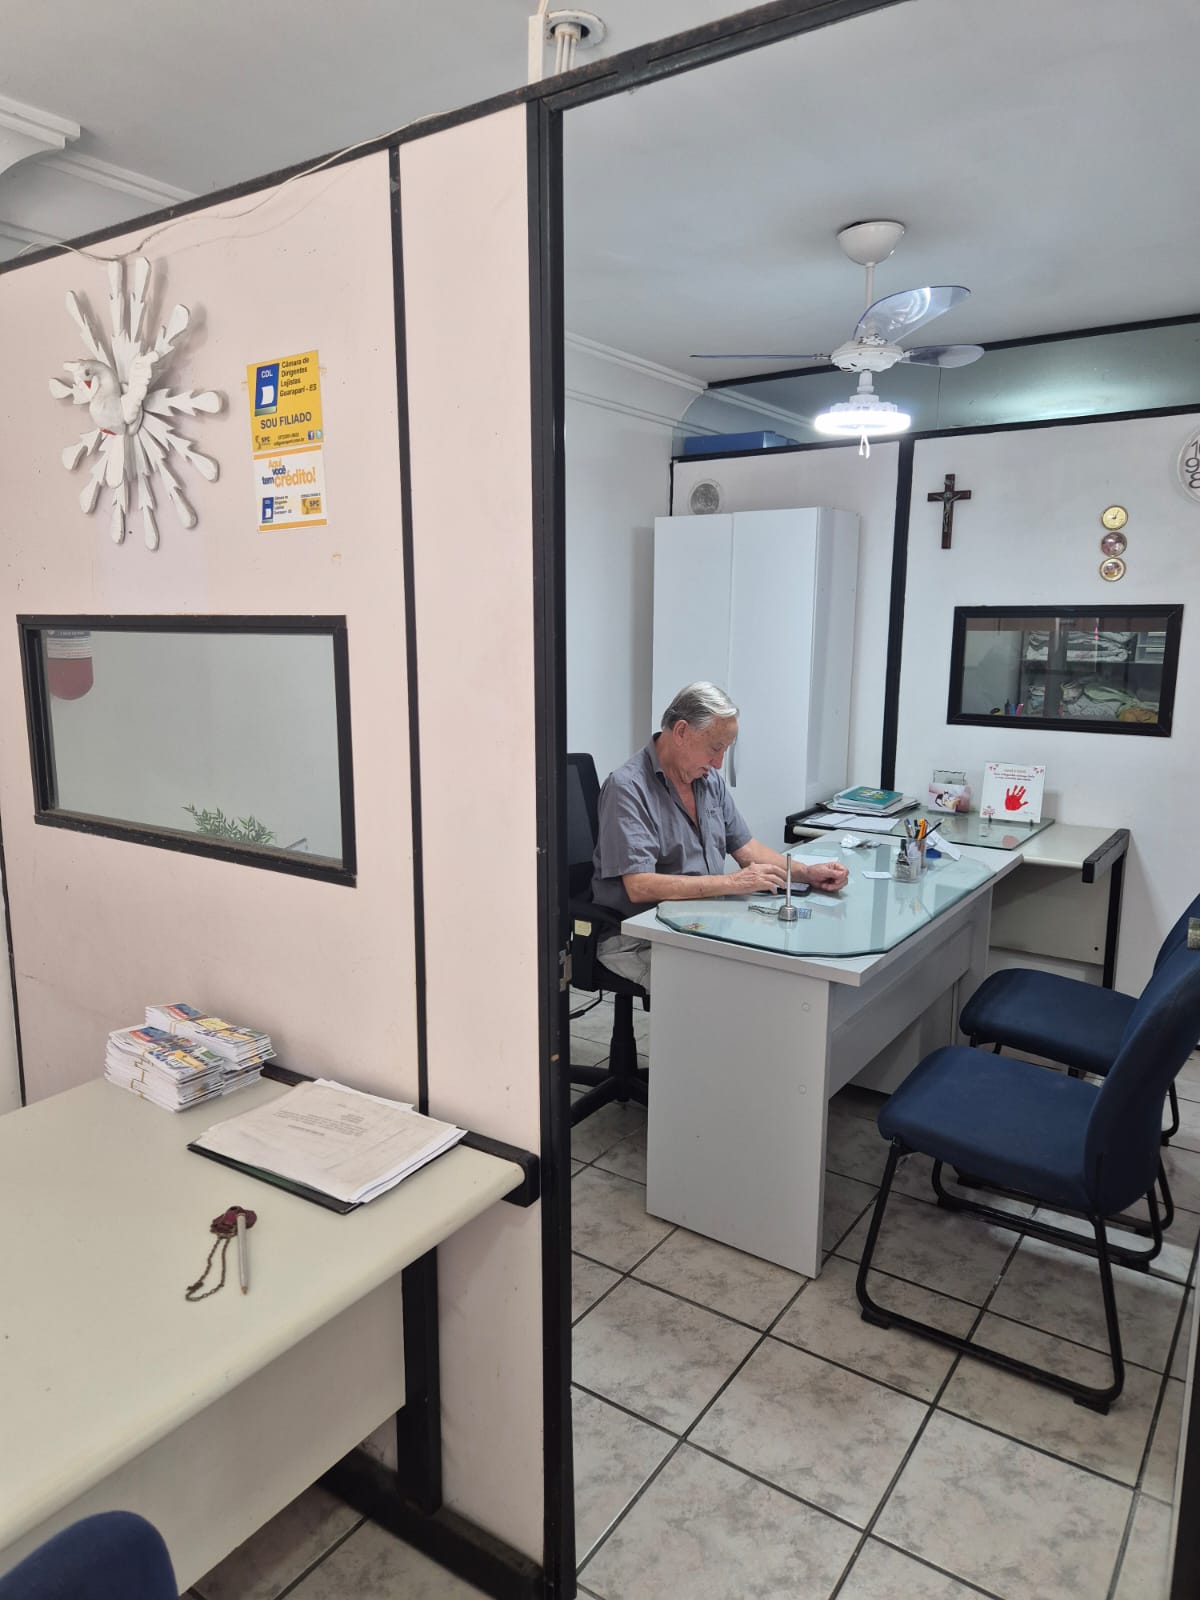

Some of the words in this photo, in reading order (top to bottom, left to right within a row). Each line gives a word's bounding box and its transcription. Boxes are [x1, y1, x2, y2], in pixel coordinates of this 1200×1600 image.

[261, 370, 273, 378] CDL
[281, 367, 308, 377] Dirigentes
[281, 378, 301, 388] Lojistas
[260, 418, 277, 429] SOU
[280, 412, 312, 426] FILIADO
[1191, 440, 1200, 458] 1
[272, 465, 286, 476] você
[1185, 457, 1200, 474] 9
[274, 466, 316, 488] crédito!
